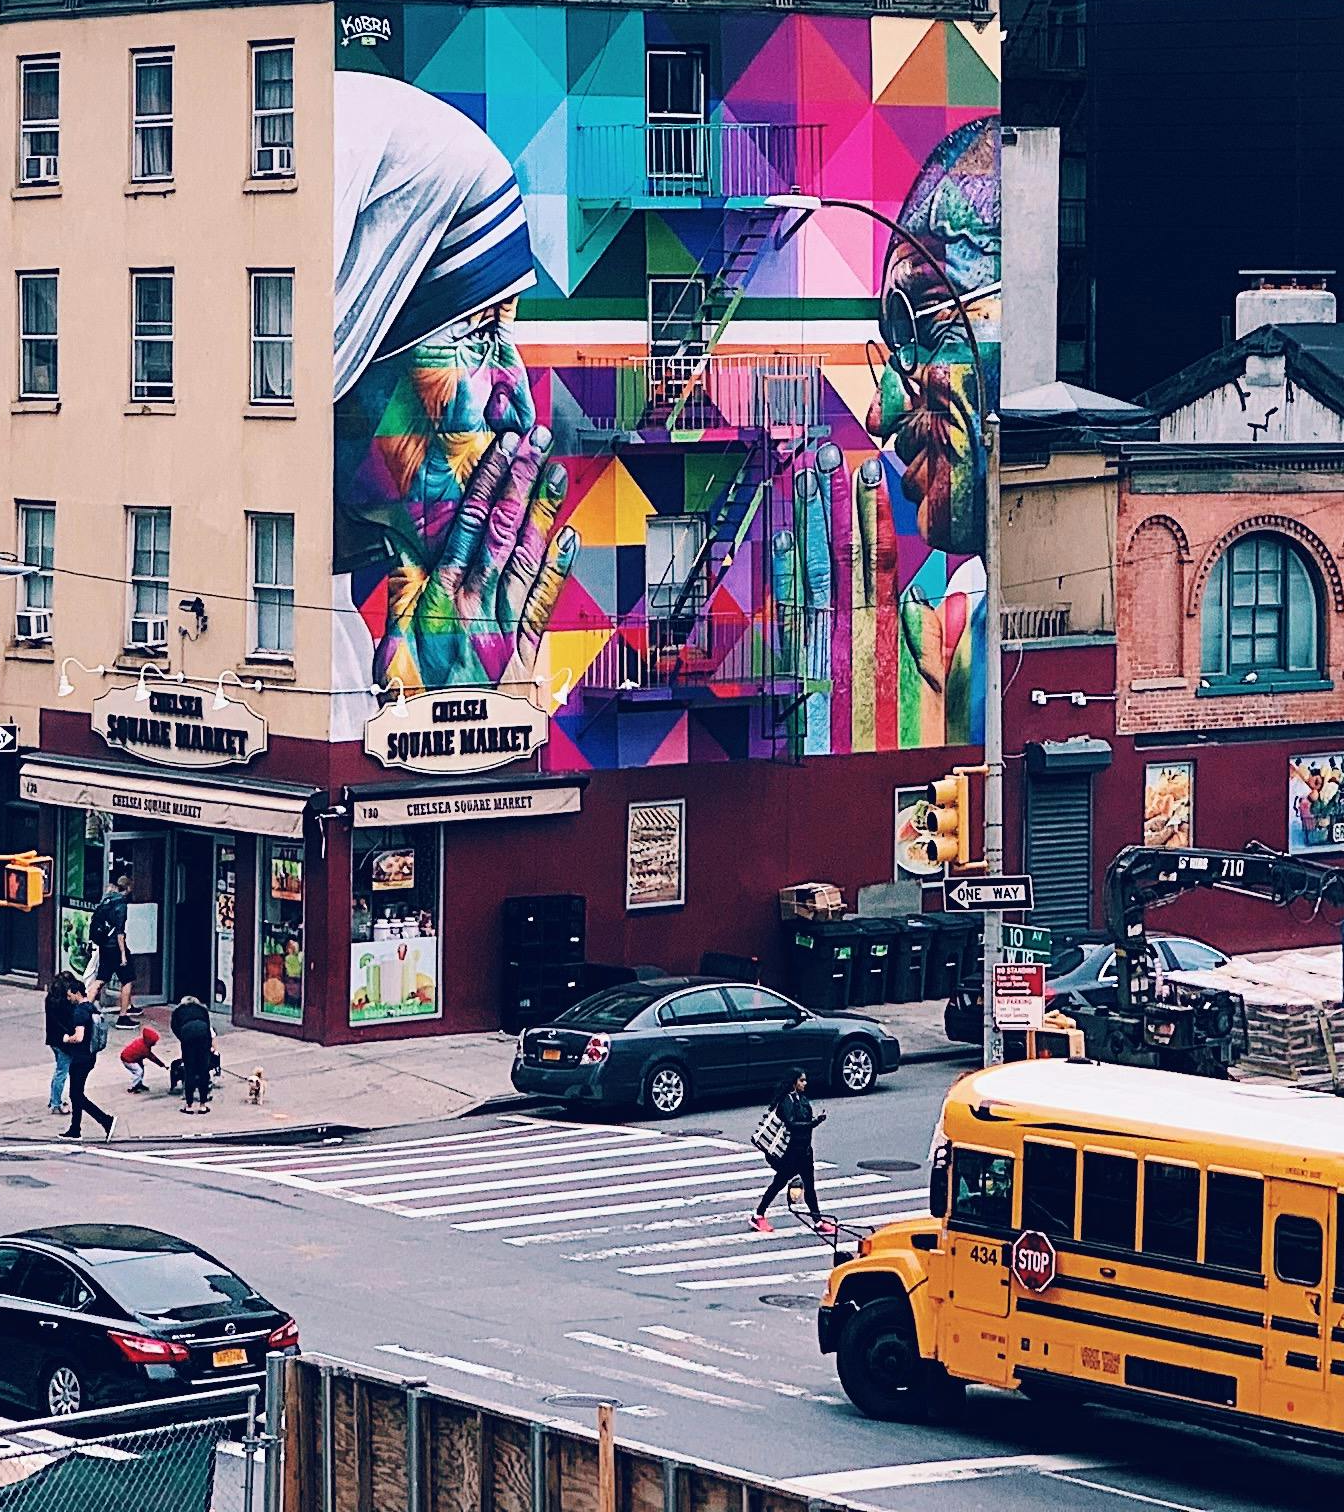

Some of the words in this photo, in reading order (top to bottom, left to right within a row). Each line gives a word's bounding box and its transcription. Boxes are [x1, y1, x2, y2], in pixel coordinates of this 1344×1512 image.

[340, 15, 392, 37] KOBRA
[149, 691, 203, 719] CHELSEA
[432, 699, 488, 723] CHELSEA
[107, 714, 171, 750] SQUARE
[174, 722, 248, 758] MARKET
[387, 729, 454, 762] SQUARE
[459, 725, 533, 753] MARKET
[112, 794, 142, 811] CHELSEA
[144, 798, 172, 815] SQUARE
[173, 801, 201, 819] MARKET
[407, 801, 451, 817] CHELSEA
[454, 798, 492, 813] SQUARE
[493, 796, 533, 811] MARKET
[1221, 859, 1245, 877] 710
[957, 887, 982, 901] ONE
[993, 887, 1019, 900] WAY
[1009, 928, 1023, 947] 10
[1031, 931, 1043, 941] AV
[1007, 950, 1017, 963] W
[1022, 951, 1034, 964] 18
[1006, 967, 1037, 975] STANDING
[970, 1245, 998, 1266] 434
[1018, 1248, 1049, 1273] STOP
